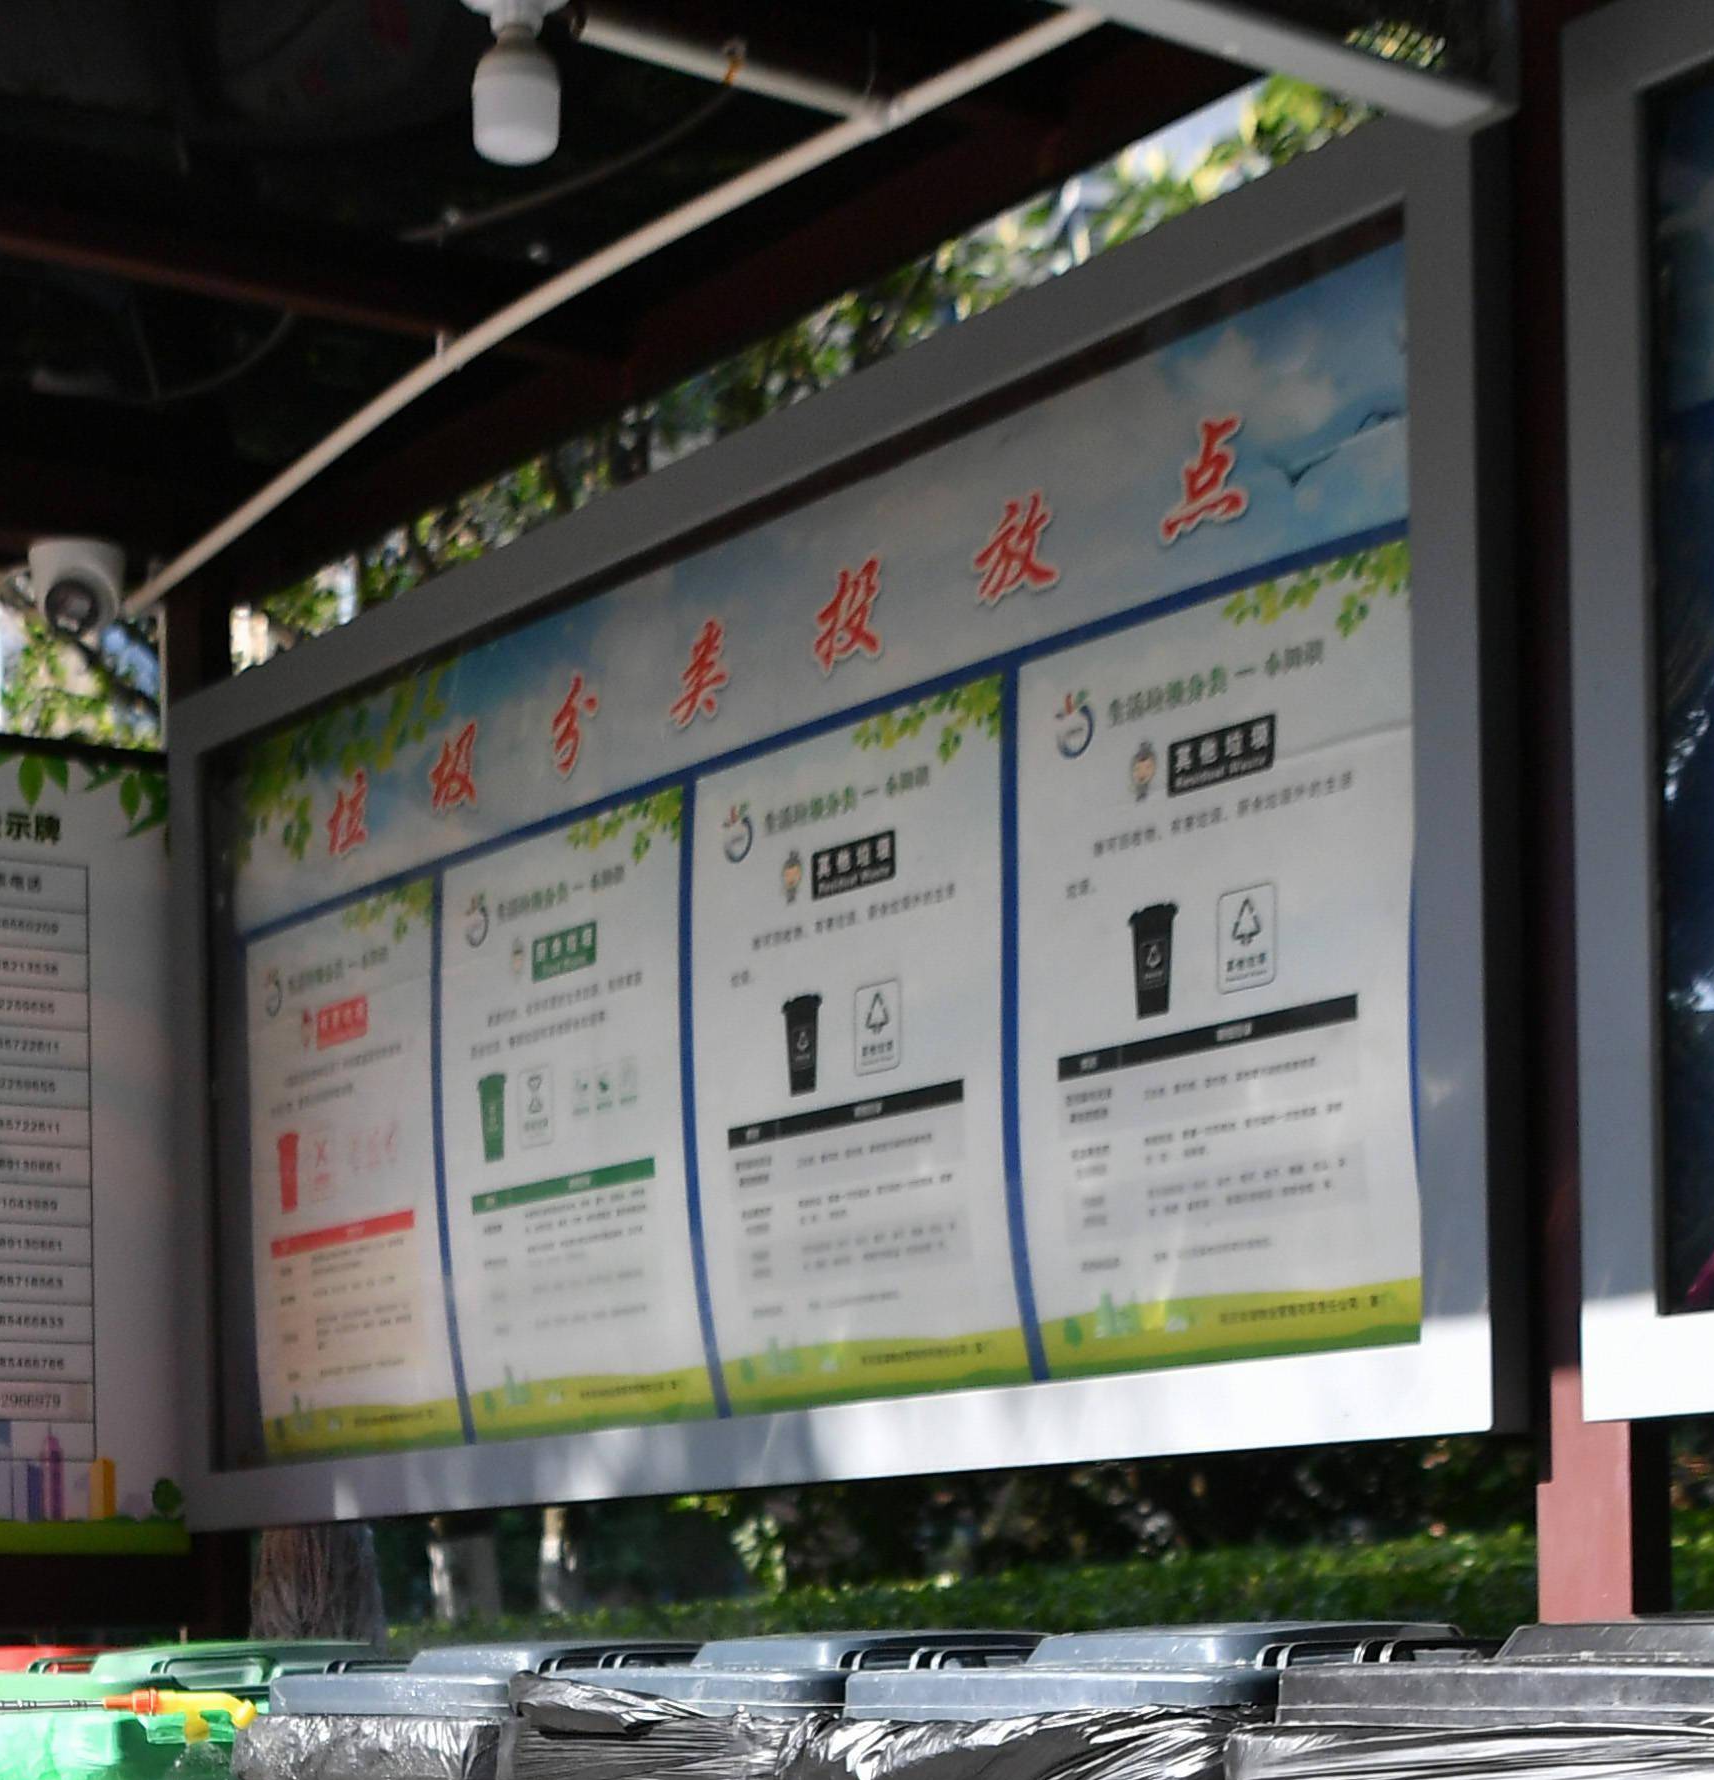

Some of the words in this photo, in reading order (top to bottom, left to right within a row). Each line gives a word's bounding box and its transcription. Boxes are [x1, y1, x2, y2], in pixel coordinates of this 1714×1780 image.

[326, 417, 1247, 858] 垃圾分类投放点
[1175, 722, 1268, 773] 其他垃圾
